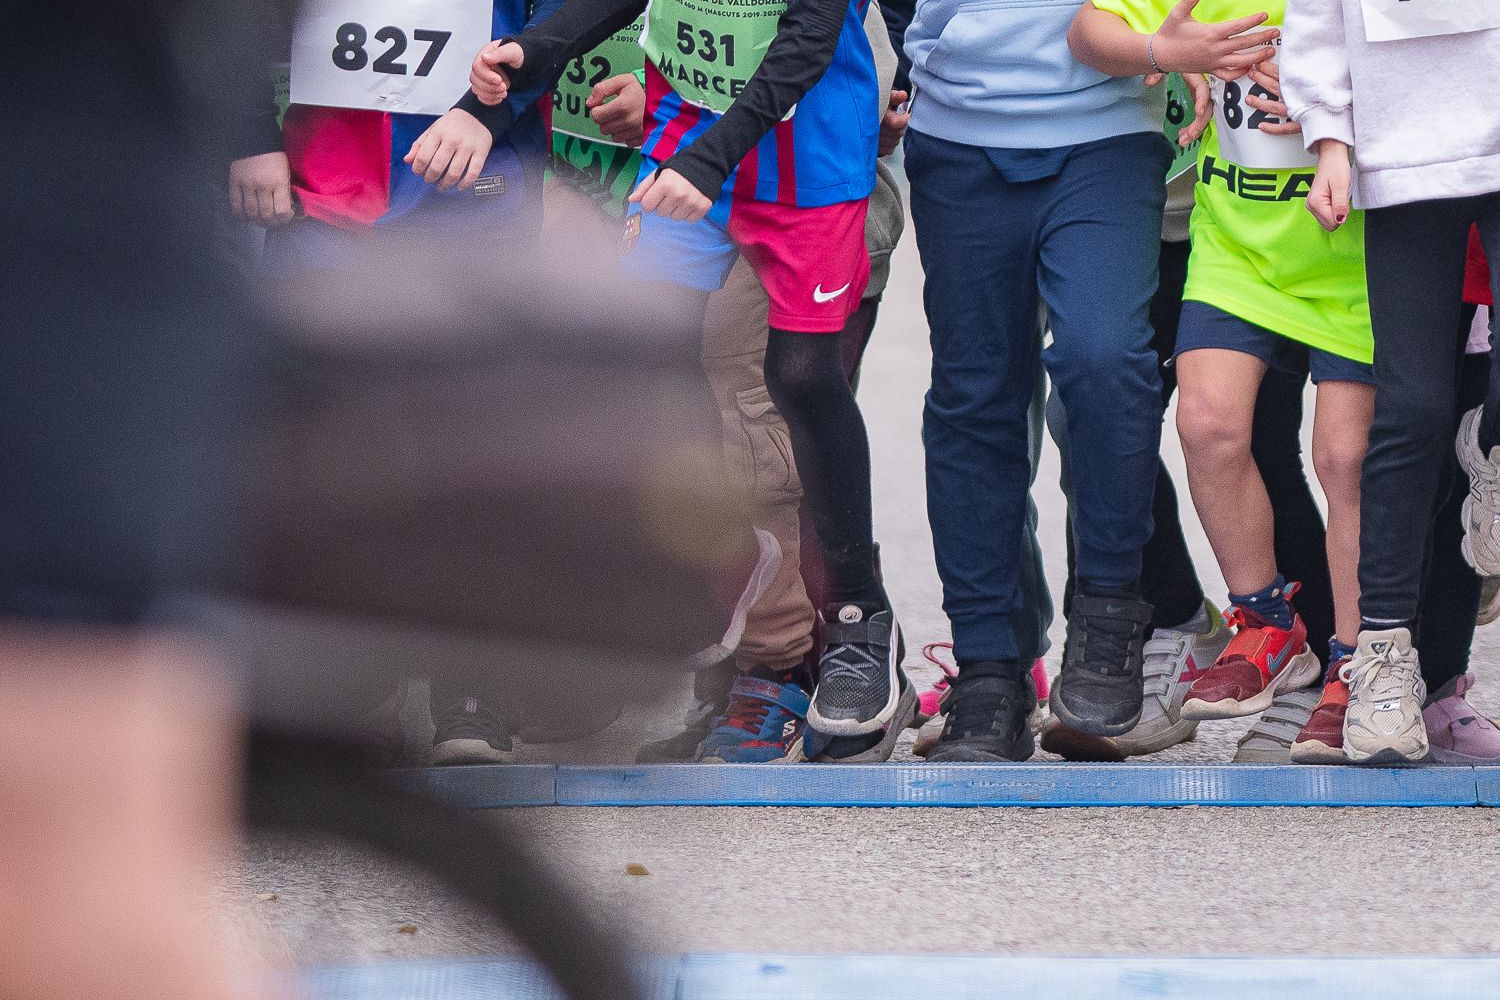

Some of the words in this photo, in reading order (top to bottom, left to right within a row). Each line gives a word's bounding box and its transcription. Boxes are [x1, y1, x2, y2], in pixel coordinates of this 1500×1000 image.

[705, 7, 741, 18] (NASCUTS
[331, 21, 453, 77] 827
[677, 20, 735, 67] 531
[658, 51, 747, 99] MARCE
[1222, 81, 1294, 130] 82
[1202, 155, 1315, 202] HEA
